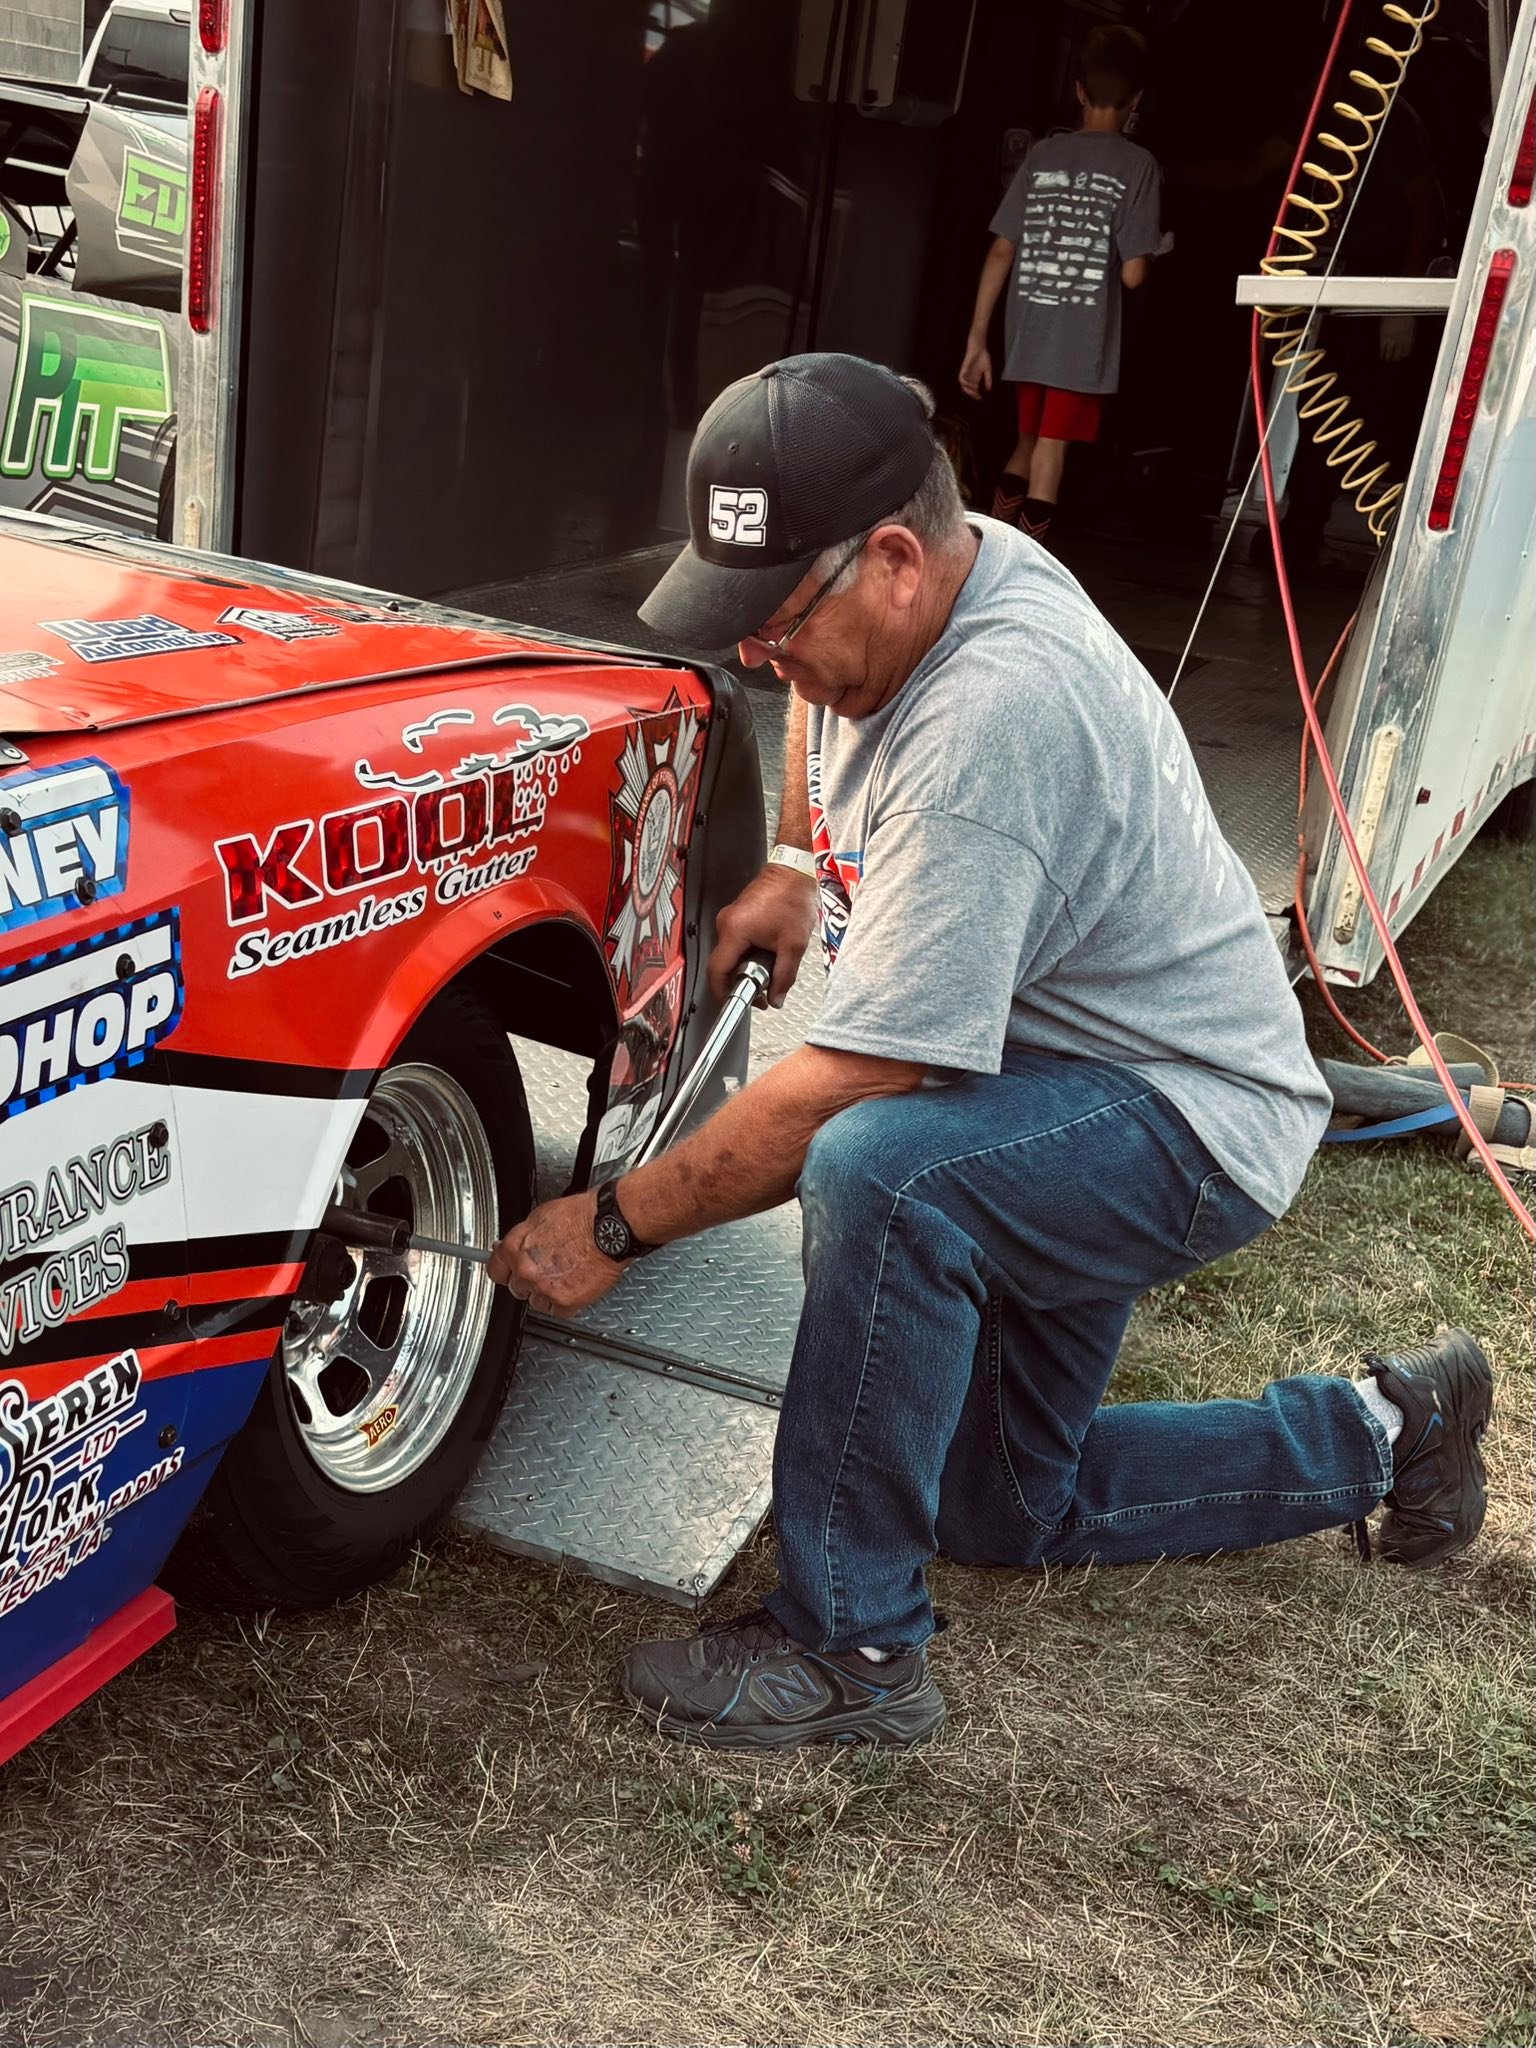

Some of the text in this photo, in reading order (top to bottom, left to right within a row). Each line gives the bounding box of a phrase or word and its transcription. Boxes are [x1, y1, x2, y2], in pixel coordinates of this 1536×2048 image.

[708, 484, 769, 547] 52
[78, 631, 232, 659] Automotive
[215, 768, 544, 925] KOOL
[231, 847, 537, 974] Seamless Gutter
[0, 1132, 169, 1253] RANCE
[81, 1426, 118, 1466] LTD
[370, 1411, 393, 1440] AERO
[22, 1505, 102, 1572] GRAIN
[105, 1451, 182, 1516] FARMS
[76, 1527, 102, 1562] IA
